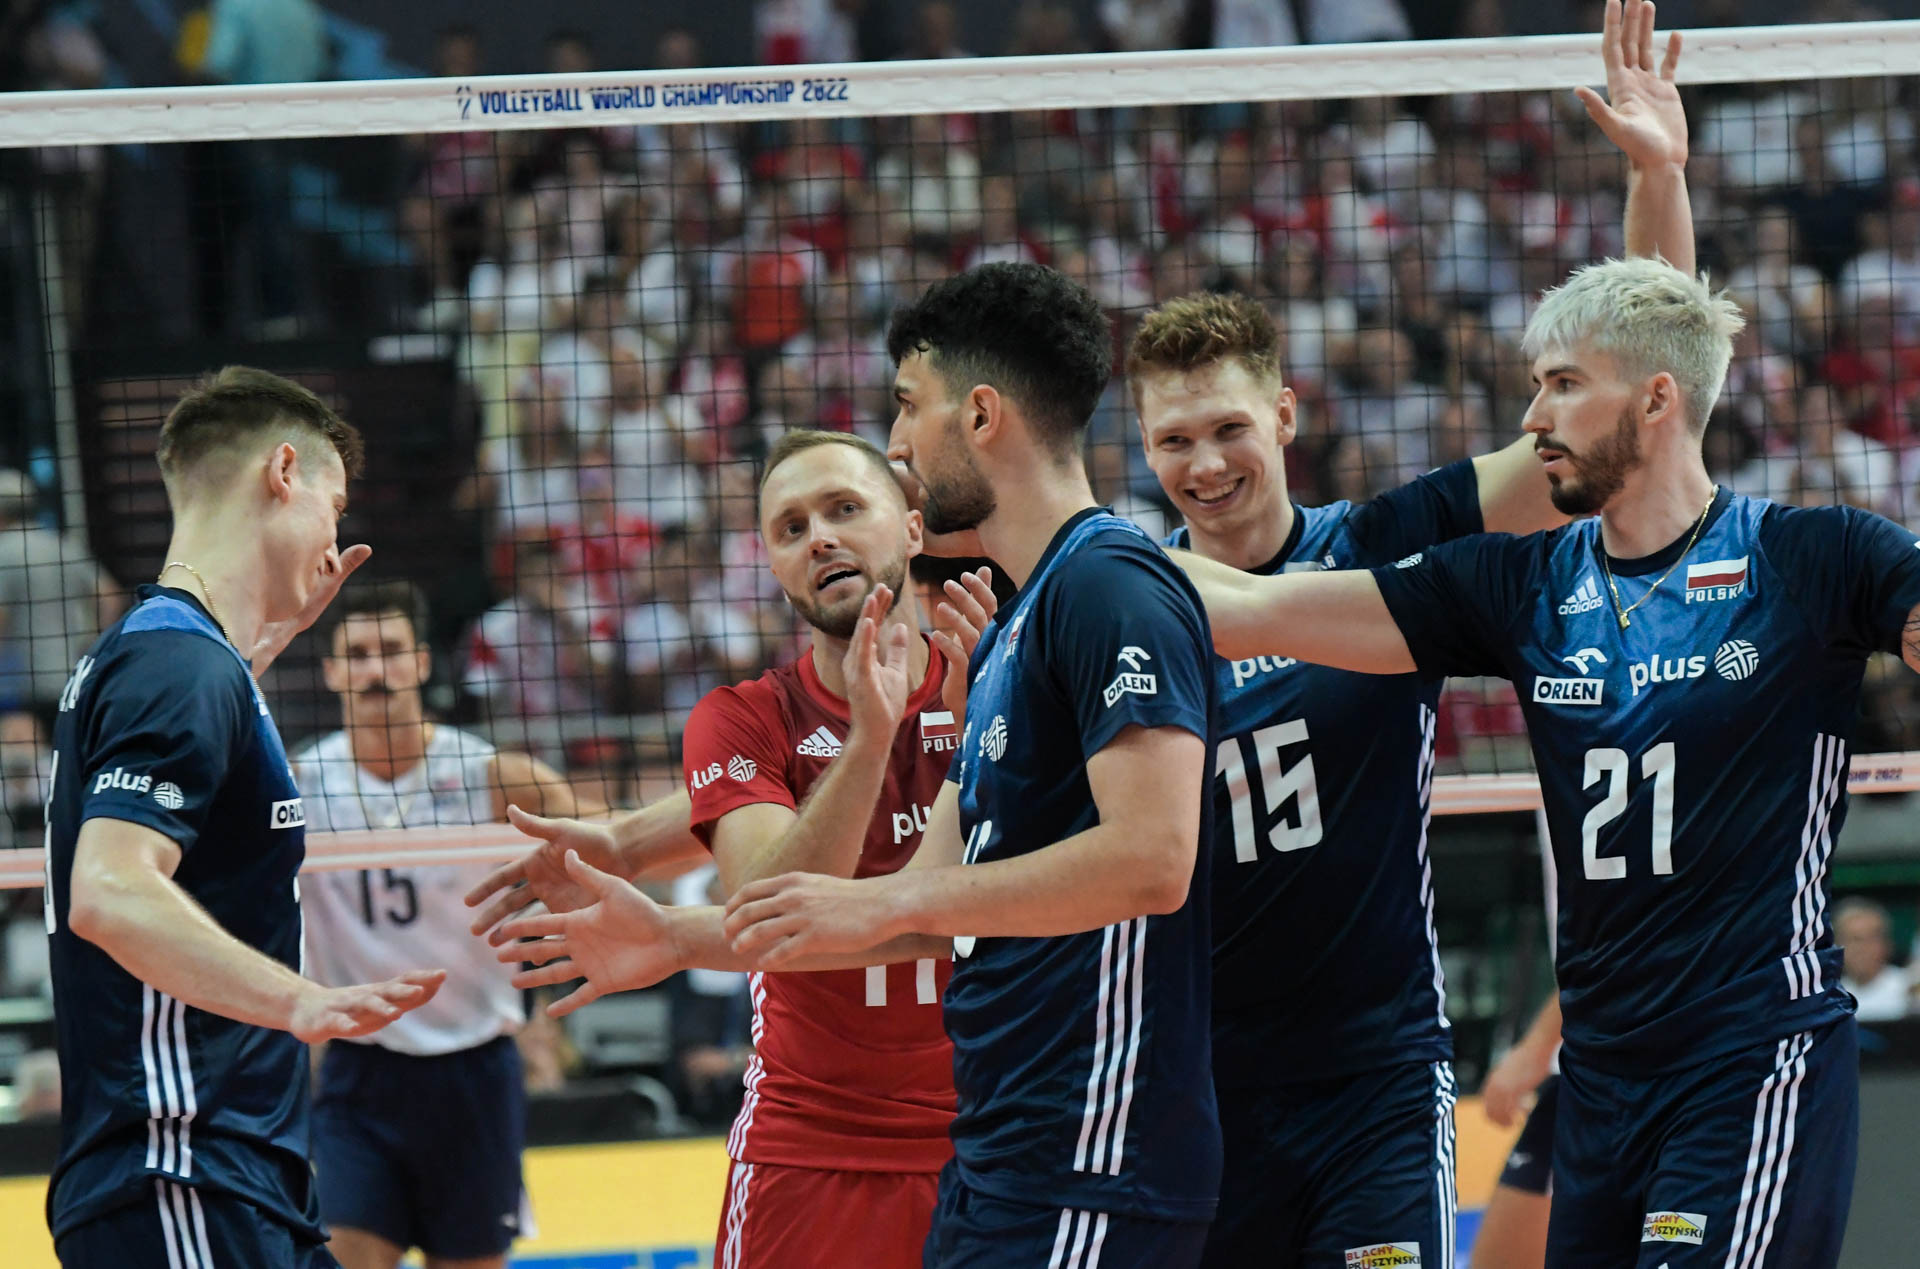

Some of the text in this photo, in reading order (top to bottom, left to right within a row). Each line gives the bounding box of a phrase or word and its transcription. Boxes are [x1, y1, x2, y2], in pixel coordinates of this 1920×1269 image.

[479, 77, 848, 114] VOLLEYBALL WORLD CHAMPIONSHIP 2022
[1557, 595, 1604, 616] adidas
[1107, 675, 1152, 701] ORLEN
[1537, 680, 1598, 700] ORLEN
[1629, 654, 1707, 697] plus
[93, 767, 153, 795] plus
[690, 762, 724, 799] lus
[1214, 718, 1323, 864] 15
[1582, 741, 1676, 880] 21
[358, 867, 419, 928] 15
[1645, 1215, 1680, 1225] BLACHY
[1346, 1246, 1393, 1261] BLACHY
